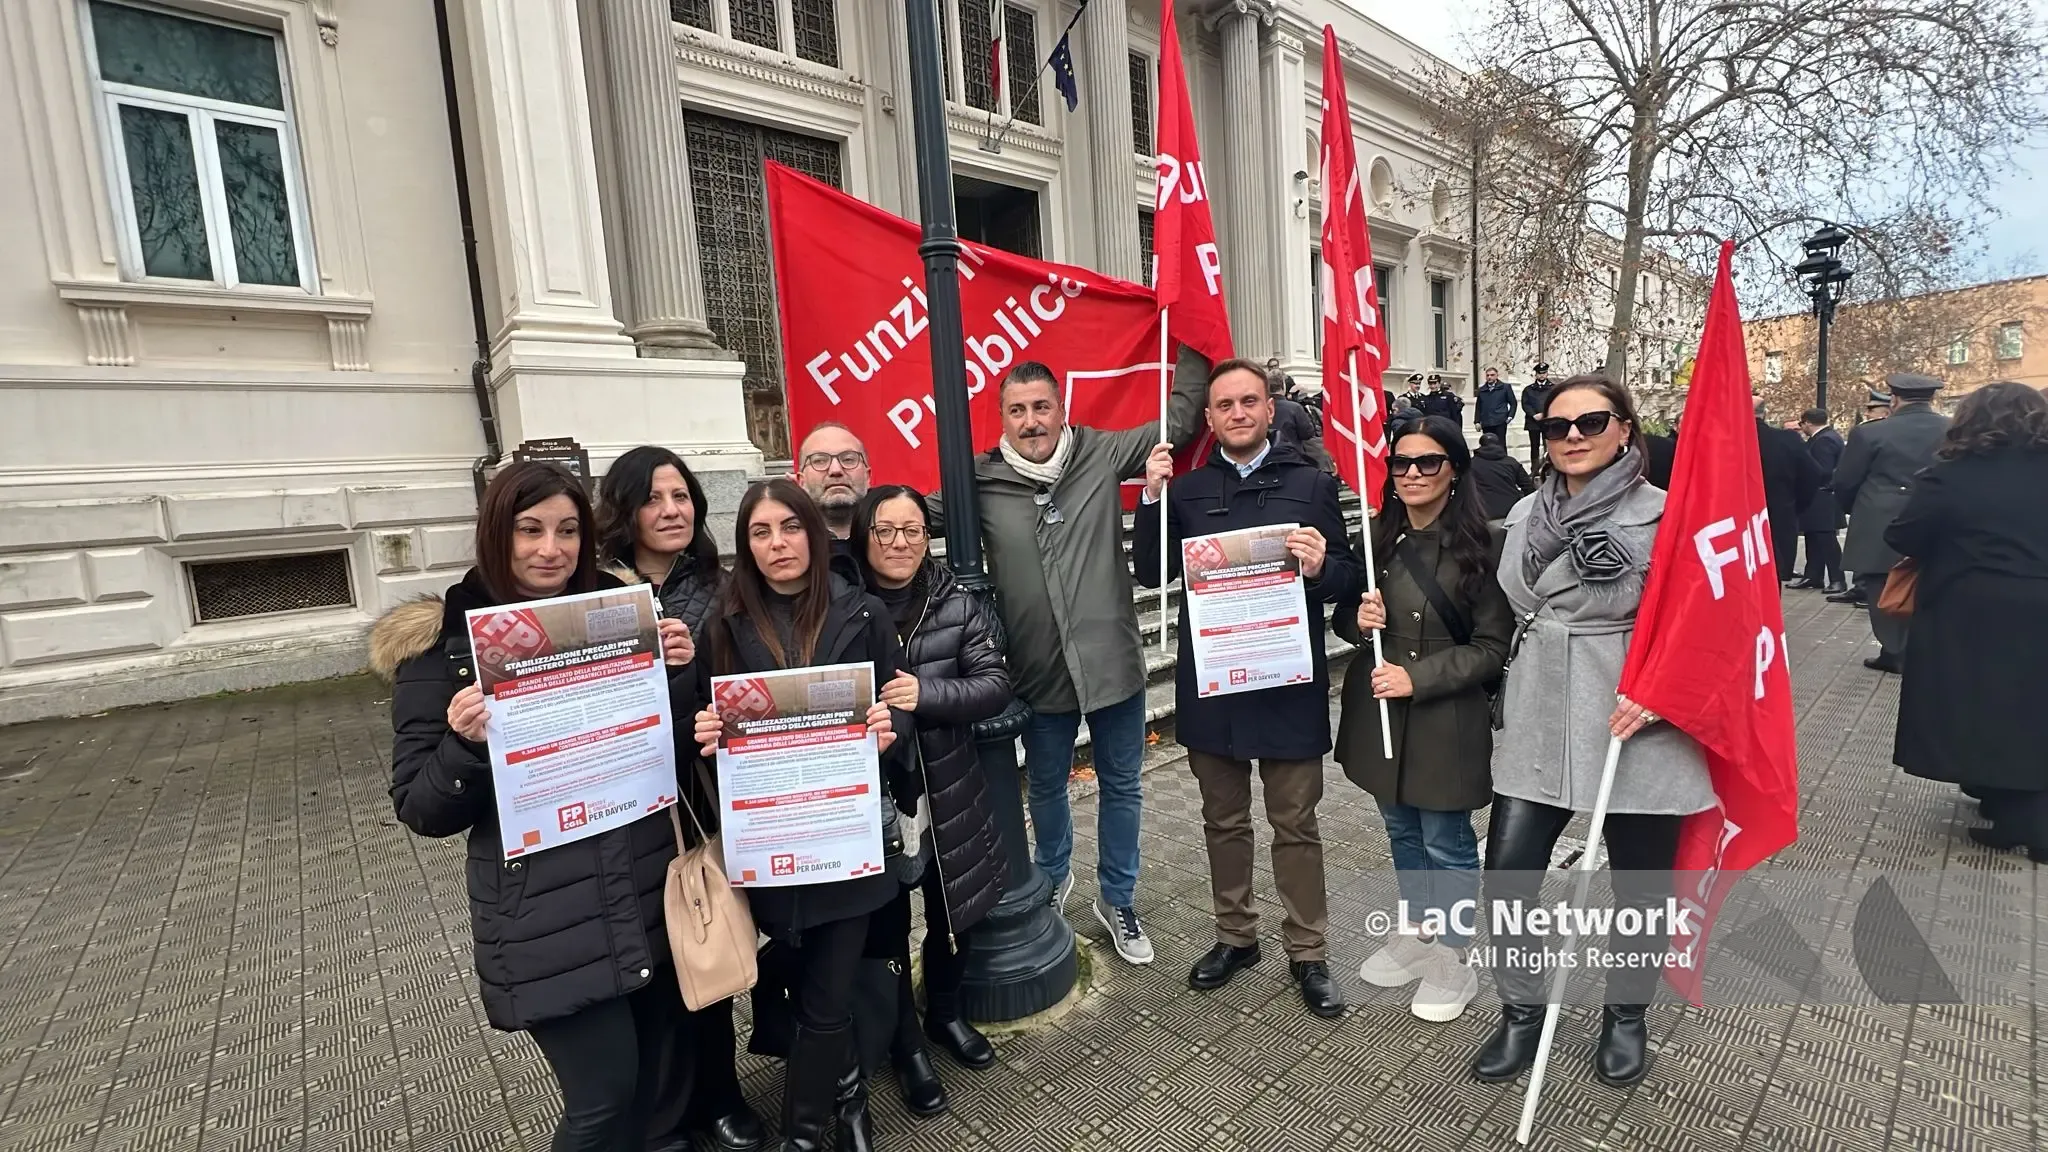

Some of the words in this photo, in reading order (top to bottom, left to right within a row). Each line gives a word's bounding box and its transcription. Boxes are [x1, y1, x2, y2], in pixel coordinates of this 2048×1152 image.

[805, 242, 992, 406] Funzin
[504, 650, 581, 671] STABILIZZAZIONE
[582, 643, 617, 657] PRECARI
[516, 660, 565, 676] MINISTERO
[566, 655, 592, 666] DELLA
[593, 647, 632, 661] GIUSTIZIA
[498, 683, 547, 698] STRAORDINARIA
[548, 679, 565, 687] DELLE
[566, 671, 602, 683] LAVORATRICI
[617, 661, 649, 673] LAVORATORI
[517, 677, 542, 688] GRANDE
[543, 671, 573, 682] RISULTATO
[574, 667, 591, 676] DELLA
[592, 659, 633, 671] MOBILITAZIONE
[737, 716, 802, 729] STABILIZZAZIONE
[802, 712, 833, 723] PRECARI
[746, 722, 787, 734] MINISTERO
[788, 720, 811, 730] DELLA
[811, 717, 847, 728] GIUSTIZIA
[561, 805, 583, 823] FP
[588, 811, 604, 822] PER
[605, 799, 638, 817] DAVVERO
[563, 818, 585, 830] CGIL
[773, 856, 792, 869] FP
[796, 865, 810, 873] PER
[810, 860, 841, 871] DAVVERO
